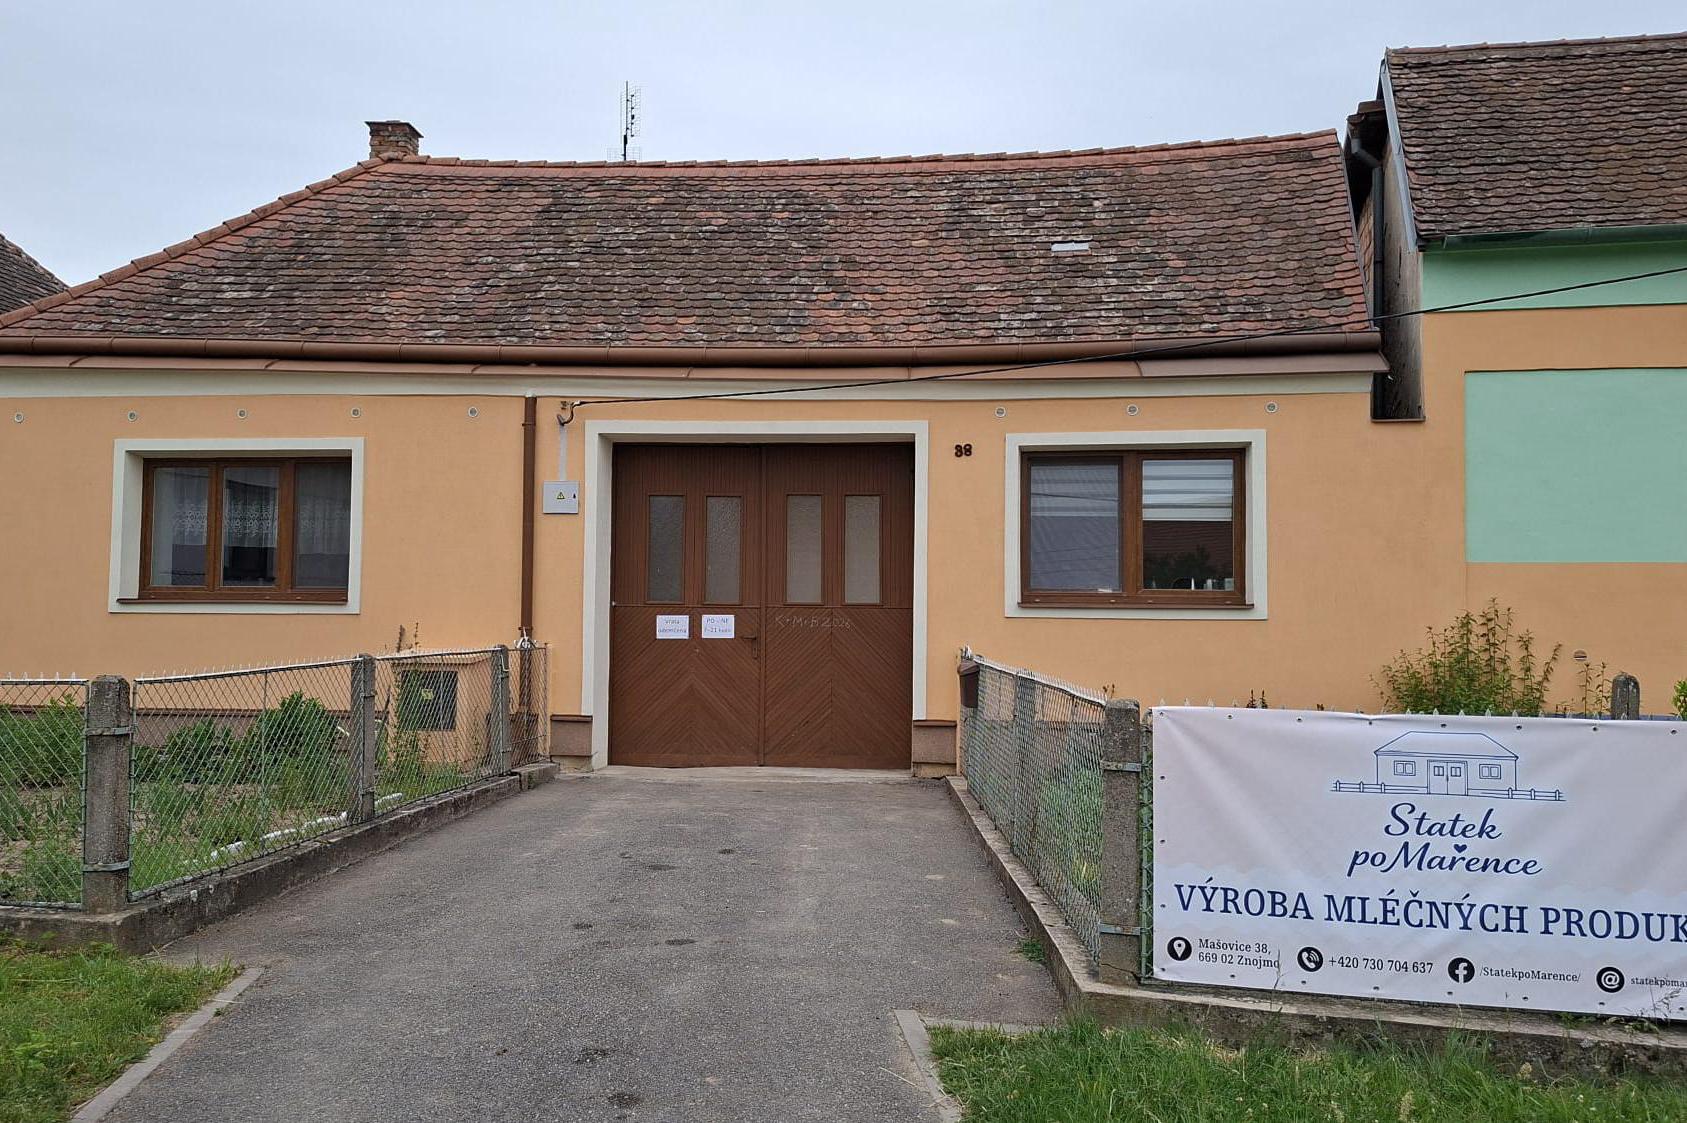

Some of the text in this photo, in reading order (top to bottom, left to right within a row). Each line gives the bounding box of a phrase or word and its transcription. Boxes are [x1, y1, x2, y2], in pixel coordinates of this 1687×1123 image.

[955, 444, 972, 459] 38
[1383, 802, 1502, 840] Statek
[1173, 876, 1687, 943] VÝROBA MLÉČNÝCH PRODUK
[1198, 938, 1272, 956] Mašovice 38,
[1198, 952, 1279, 970] 669 02 Znojmo
[1328, 955, 1434, 974] +420 730 704 637
